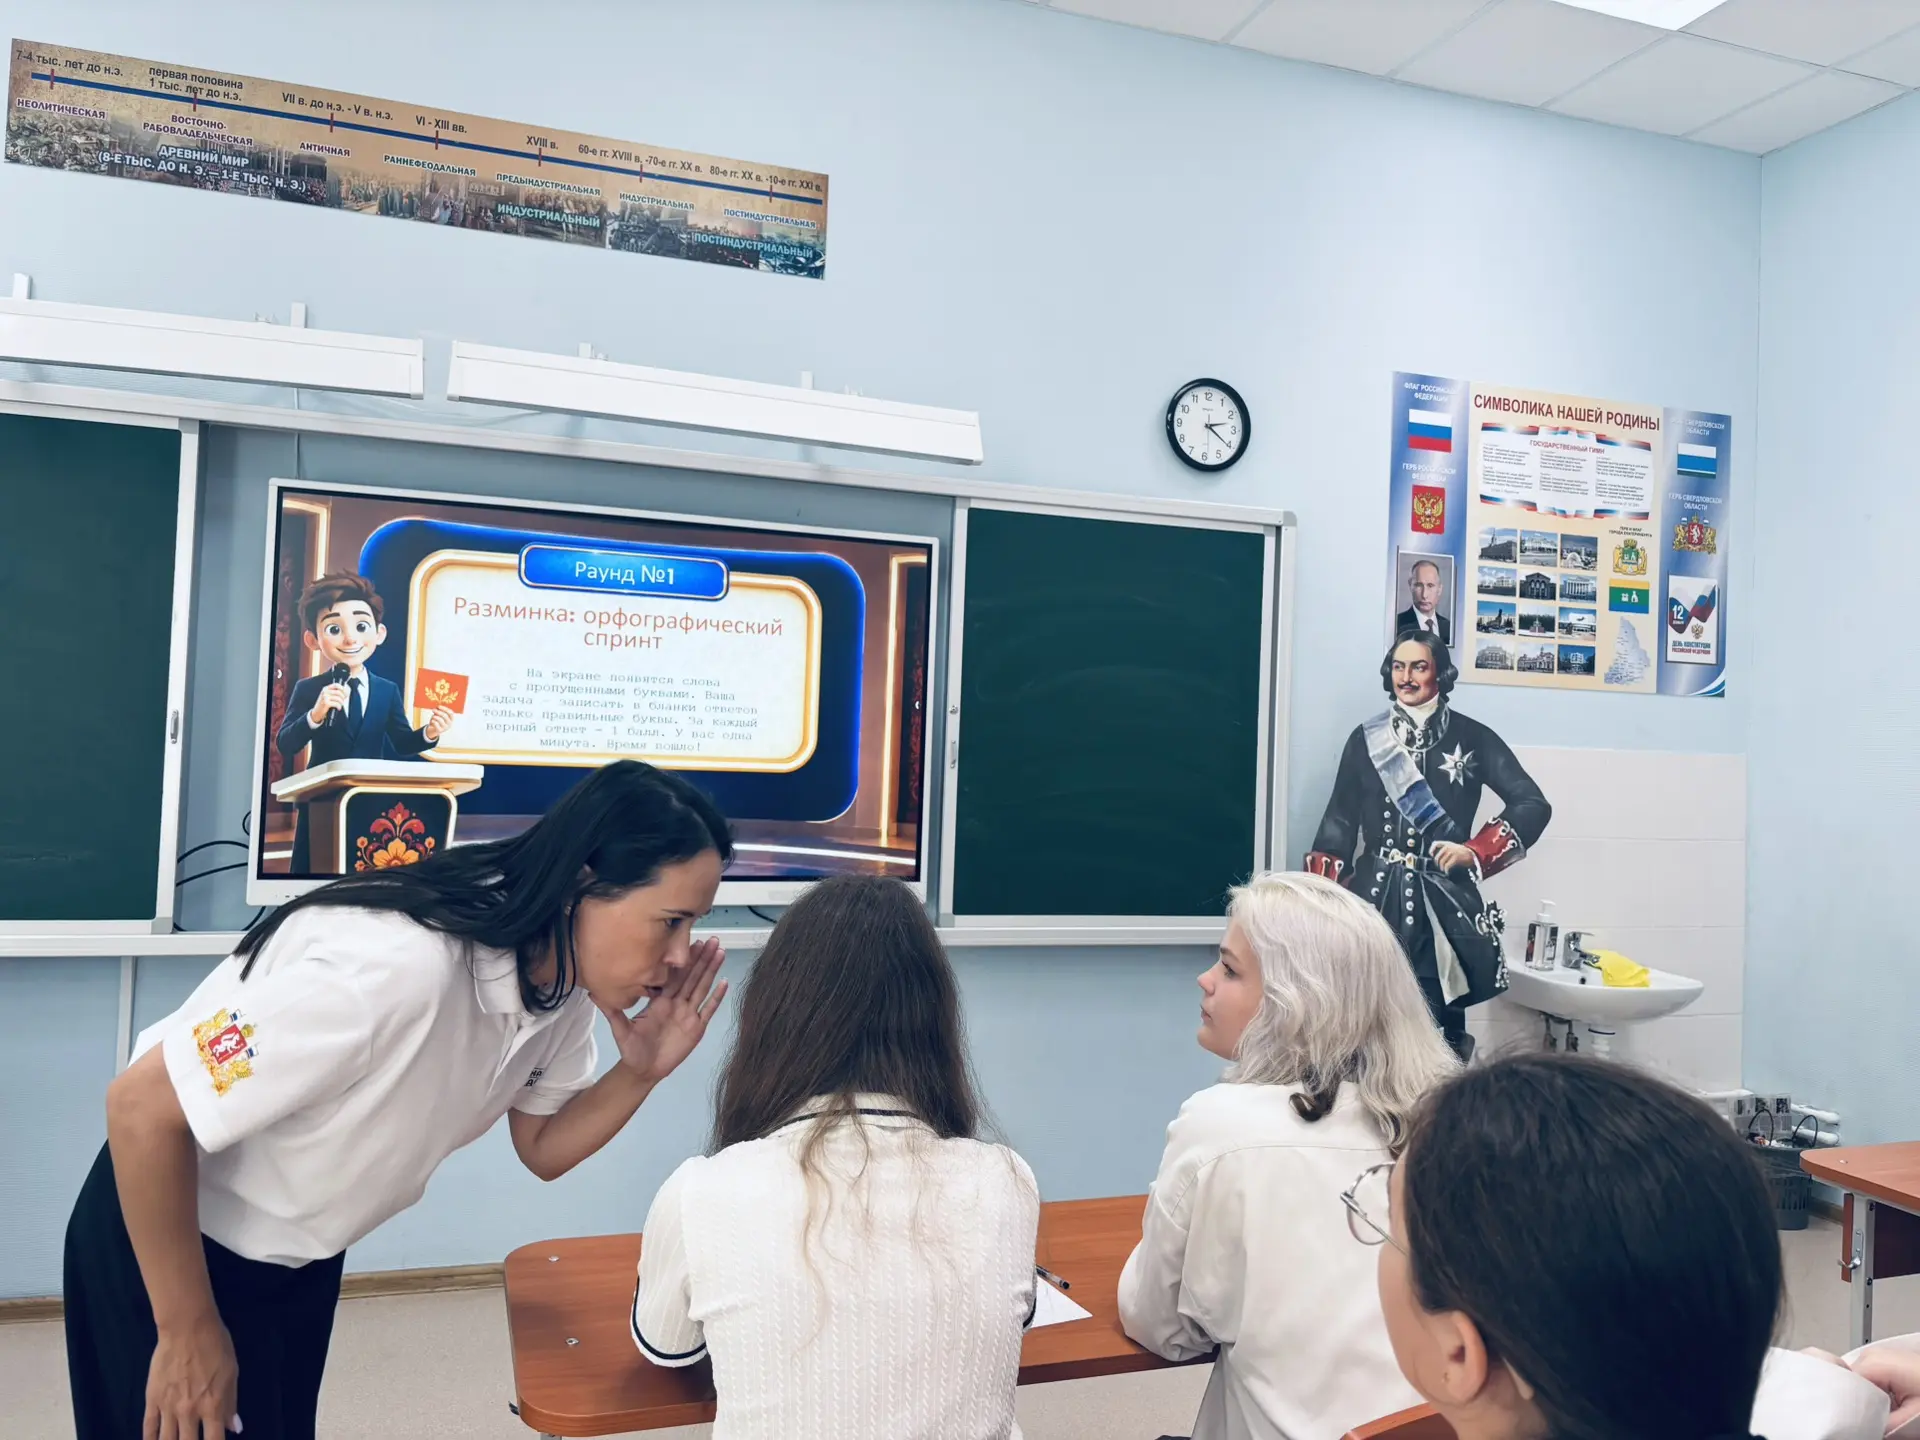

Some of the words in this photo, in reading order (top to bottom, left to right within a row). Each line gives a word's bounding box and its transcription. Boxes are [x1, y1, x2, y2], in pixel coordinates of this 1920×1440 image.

[16, 50, 33, 62] 7-4
[36, 54, 61, 67] тыс.
[64, 59, 84, 71] лет
[86, 62, 102, 74] до
[104, 66, 124, 78] н.э.
[148, 66, 188, 84] первая
[190, 74, 244, 90] половина
[150, 78, 156, 88] 1
[158, 80, 182, 93] тыс.
[185, 84, 204, 96] лет
[206, 87, 220, 100] до
[222, 91, 242, 102] н.э.
[16, 98, 106, 120] НЕОЛИТИЧЕСКАЯ
[298, 96, 308, 107] в.
[310, 99, 324, 110] до
[326, 101, 345, 112] н.э.
[364, 108, 373, 118] в.
[376, 109, 394, 120] н.э.
[171, 114, 227, 130] ВОСТОЧНО-
[452, 123, 468, 134] вв.
[142, 122, 253, 146] РАБОВЛАДЕЛЬЧЕСКАЯ
[299, 142, 350, 158] АНТИЧНАЯ
[550, 140, 558, 150] в.
[158, 144, 219, 164] ДРЕВНИЙ
[222, 152, 250, 168] МИР
[384, 154, 476, 177] РАННЕФЕОДАЛЬНАЯ
[578, 144, 598, 156] 60-е
[600, 150, 610, 158] гг.
[634, 154, 643, 164] в.
[644, 153, 666, 168] -70-е
[668, 159, 678, 170] гг.
[694, 164, 703, 174] в.
[98, 151, 122, 165] (8-Е
[124, 154, 155, 170] ТЫС.
[158, 159, 176, 173] ДО
[179, 162, 192, 174] Н.
[194, 165, 206, 176] Э.
[222, 168, 240, 182] 1-Е
[242, 172, 272, 187] ТЫС.
[275, 178, 286, 189] Н.
[290, 180, 307, 194] Э.)
[710, 165, 728, 178] 80-е
[730, 170, 740, 180] гг.
[756, 174, 764, 182] в.
[788, 179, 798, 190] гг.
[814, 183, 823, 193] в.
[496, 173, 602, 197] ПРЕДЫНДУСТРИАЛЬНАЯ
[619, 192, 695, 211] ИНДУСТРИАЛЬНАЯ
[497, 202, 601, 228] ИНДУСТРИАЛЬНЫЙ
[724, 208, 816, 230] ПОСТИНДУСТРИАЛЬНАЯ
[694, 232, 814, 258] ПОСТИНДУСТРИАЛЬНЫЙ
[1192, 394, 1198, 404] 11
[1204, 392, 1214, 402] 12
[1220, 398, 1224, 408] 1
[1181, 404, 1190, 414] 10
[1228, 410, 1234, 420] 2
[1474, 394, 1554, 418] СИМВОЛИКА
[1557, 404, 1604, 424] НАШЕЙ
[1606, 411, 1660, 432] РОДИНЫ
[1176, 418, 1182, 428] 9
[1230, 426, 1236, 435] 3
[1179, 434, 1185, 443] 8
[1226, 440, 1232, 450] 4
[1530, 439, 1588, 454] ГОСУДАРСТВЕННЫЙ
[1588, 446, 1605, 455] ГИМН
[1188, 446, 1195, 454] 7
[1202, 452, 1208, 461] 6
[1216, 450, 1222, 459] 5
[575, 560, 636, 586] Раунд
[640, 564, 675, 585] №1
[454, 597, 576, 624] Разминка:
[583, 608, 784, 636] орфографический
[1672, 605, 1684, 620] 12
[583, 628, 663, 652] спринт
[526, 668, 542, 678] На
[552, 670, 601, 682] экране
[610, 673, 674, 685] появятся
[682, 678, 720, 688] слова
[509, 682, 518, 690] с
[526, 682, 626, 696] пропущенными
[633, 687, 696, 699] буквами.
[705, 690, 736, 701] Ваша
[482, 694, 534, 705] задача
[560, 698, 624, 709] записать
[648, 701, 696, 712] бланки
[704, 706, 758, 716] ответов
[482, 708, 534, 718] только
[542, 711, 624, 722] правильные
[632, 714, 678, 725] буквы.
[688, 716, 703, 726] За
[712, 718, 758, 728] каждый
[486, 722, 536, 733] верный
[546, 724, 587, 734] ответ
[692, 730, 715, 740] вас
[540, 738, 596, 749] минута.
[606, 739, 647, 752] Время
[656, 742, 701, 752] пошло!
